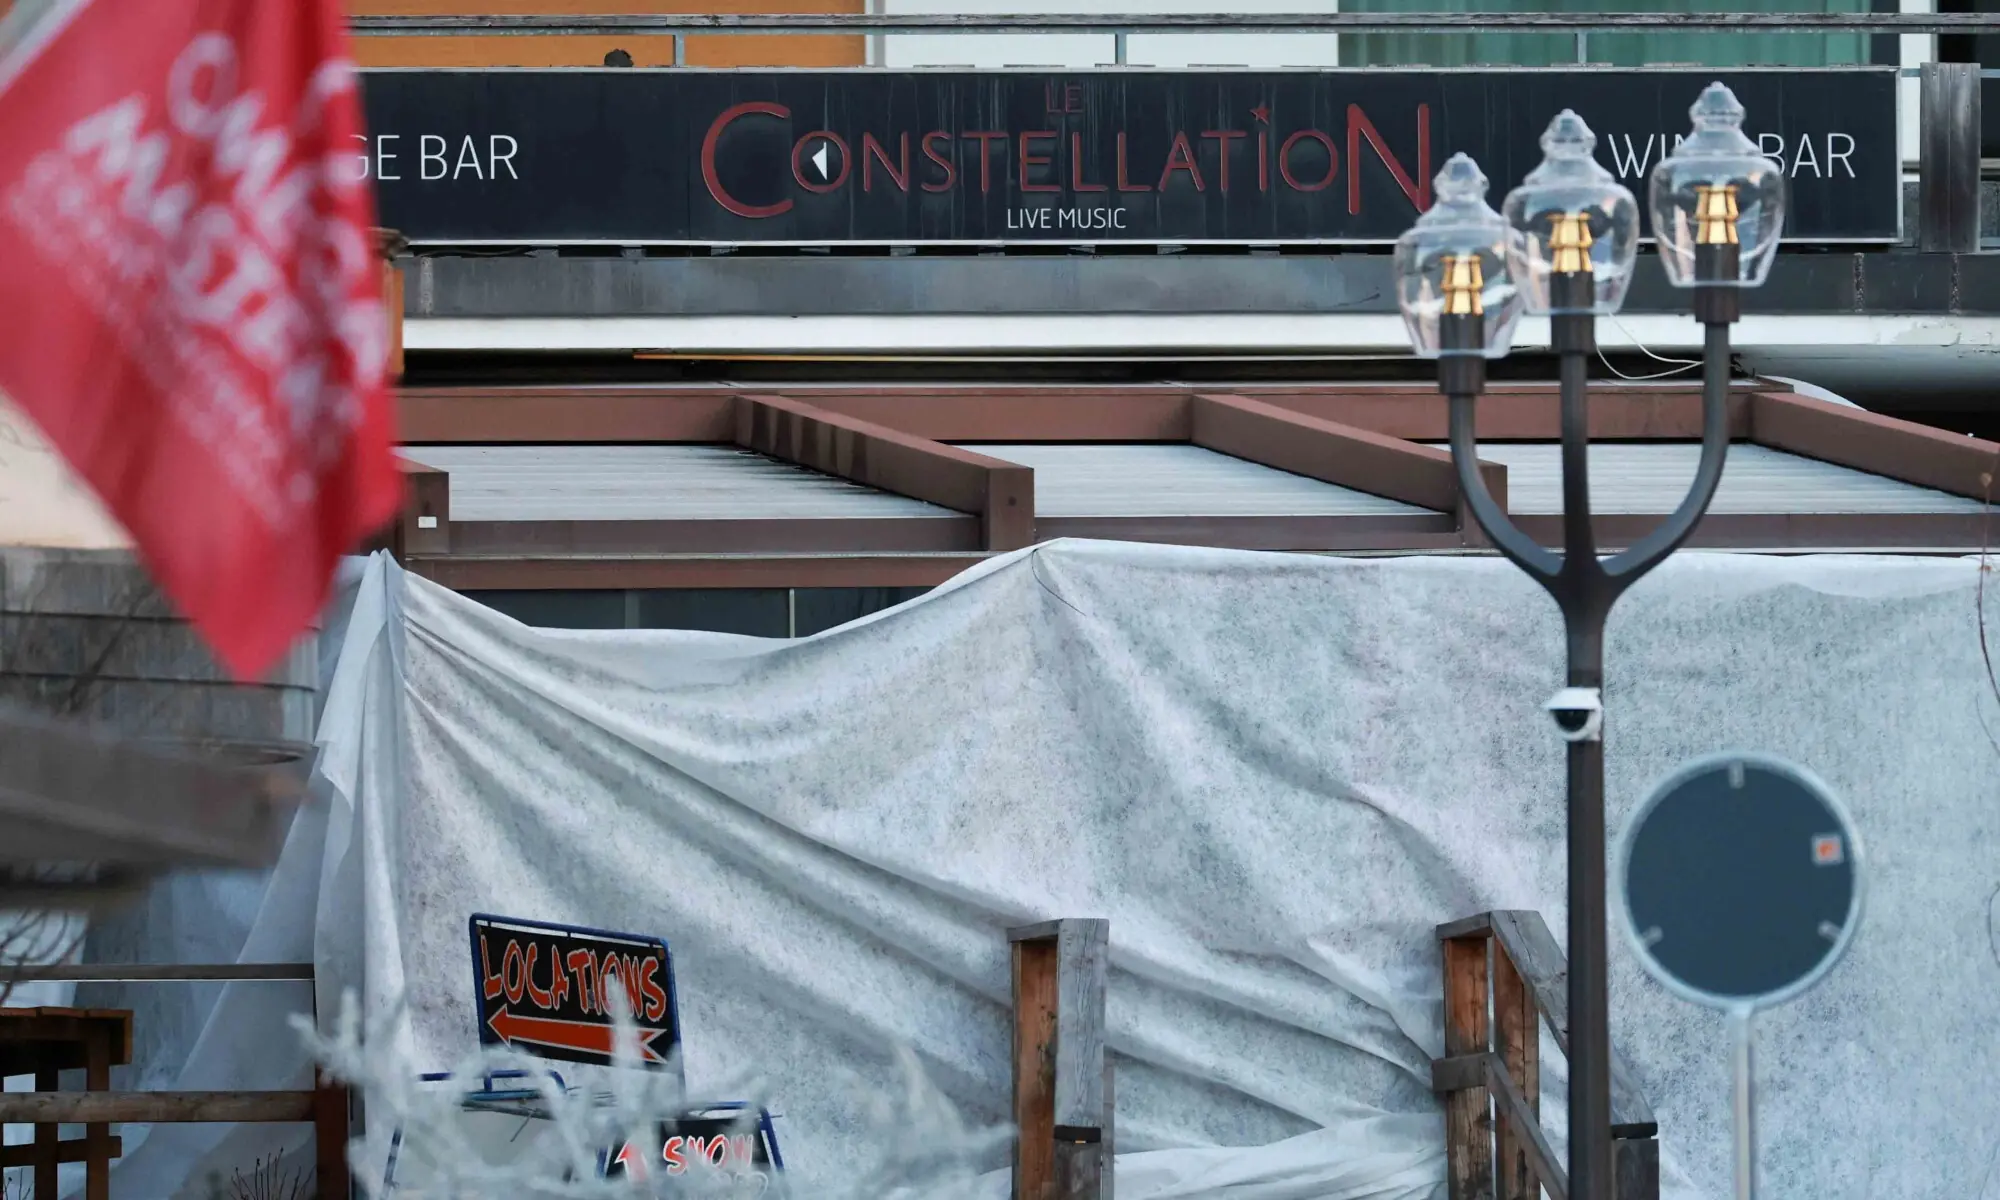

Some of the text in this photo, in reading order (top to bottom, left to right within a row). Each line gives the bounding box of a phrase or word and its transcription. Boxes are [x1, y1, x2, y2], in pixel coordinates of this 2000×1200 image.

[1045, 83, 1083, 113] LE
[420, 134, 518, 180] BAR
[1758, 132, 1856, 179] BAR
[1007, 208, 1127, 229] LIVE MUSIC
[480, 934, 666, 1022] LOCATIONS
